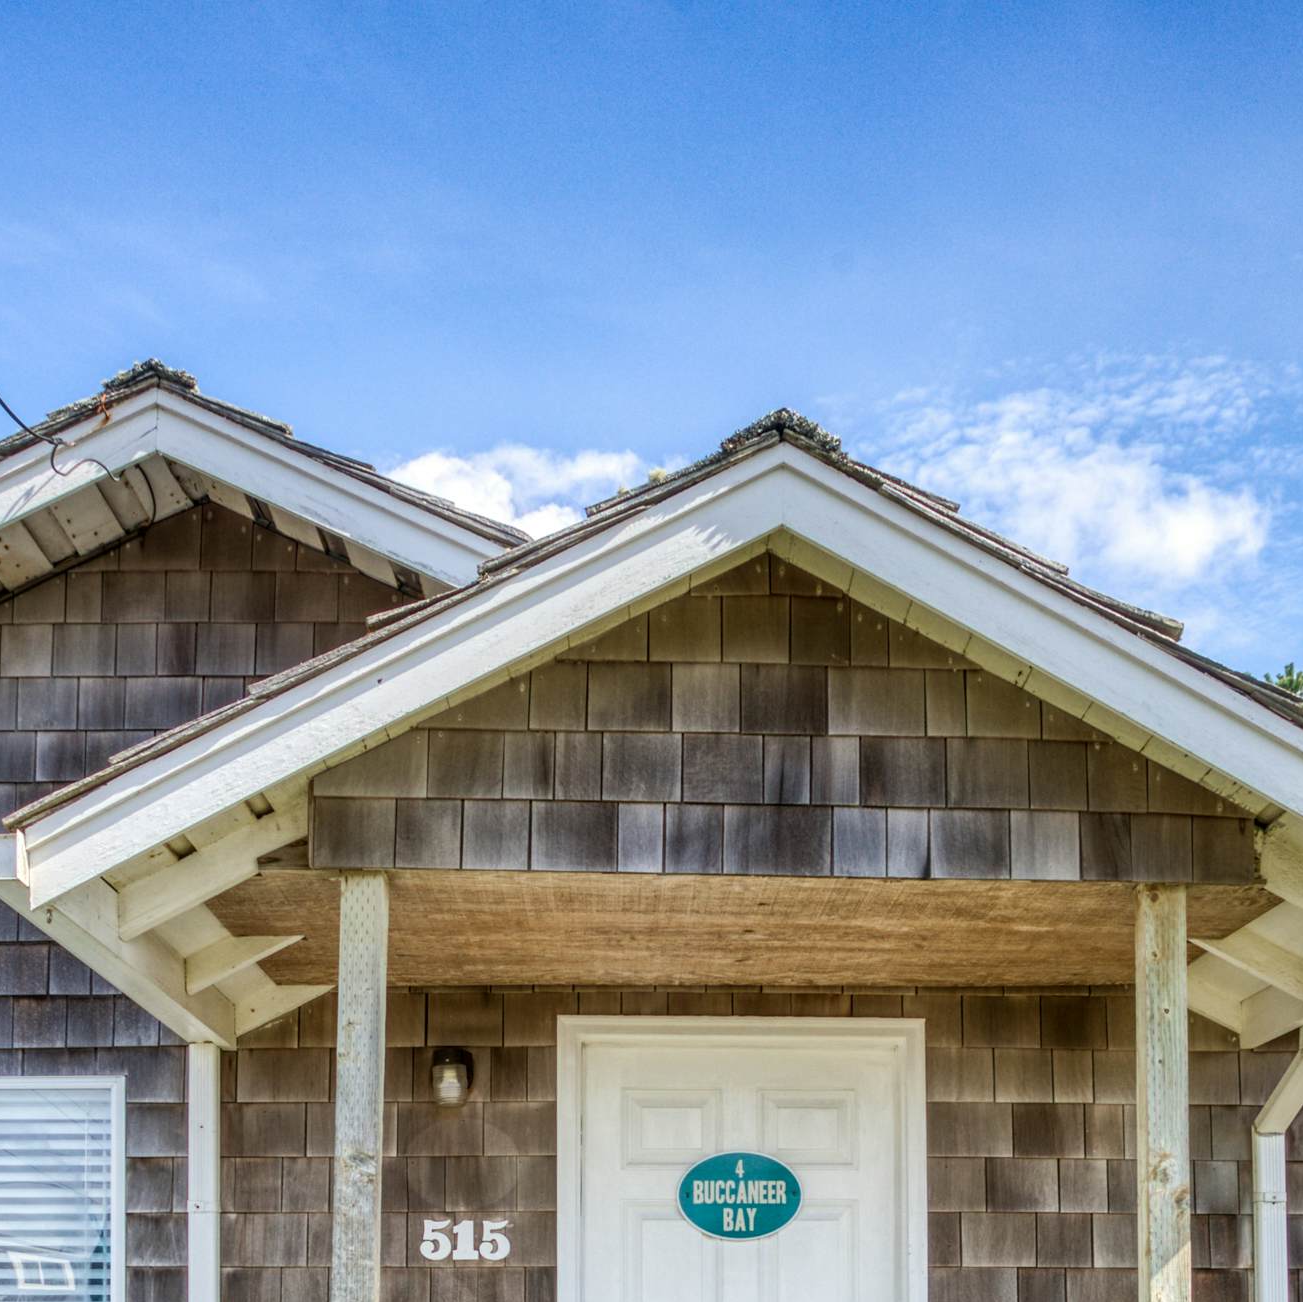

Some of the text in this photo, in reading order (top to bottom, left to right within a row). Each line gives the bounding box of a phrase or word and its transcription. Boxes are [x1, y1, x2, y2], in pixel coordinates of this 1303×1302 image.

[735, 1159, 745, 1178] 4
[692, 1180, 787, 1204] BUCCANEER
[723, 1207, 757, 1231] BAY
[420, 1219, 511, 1261] 515
